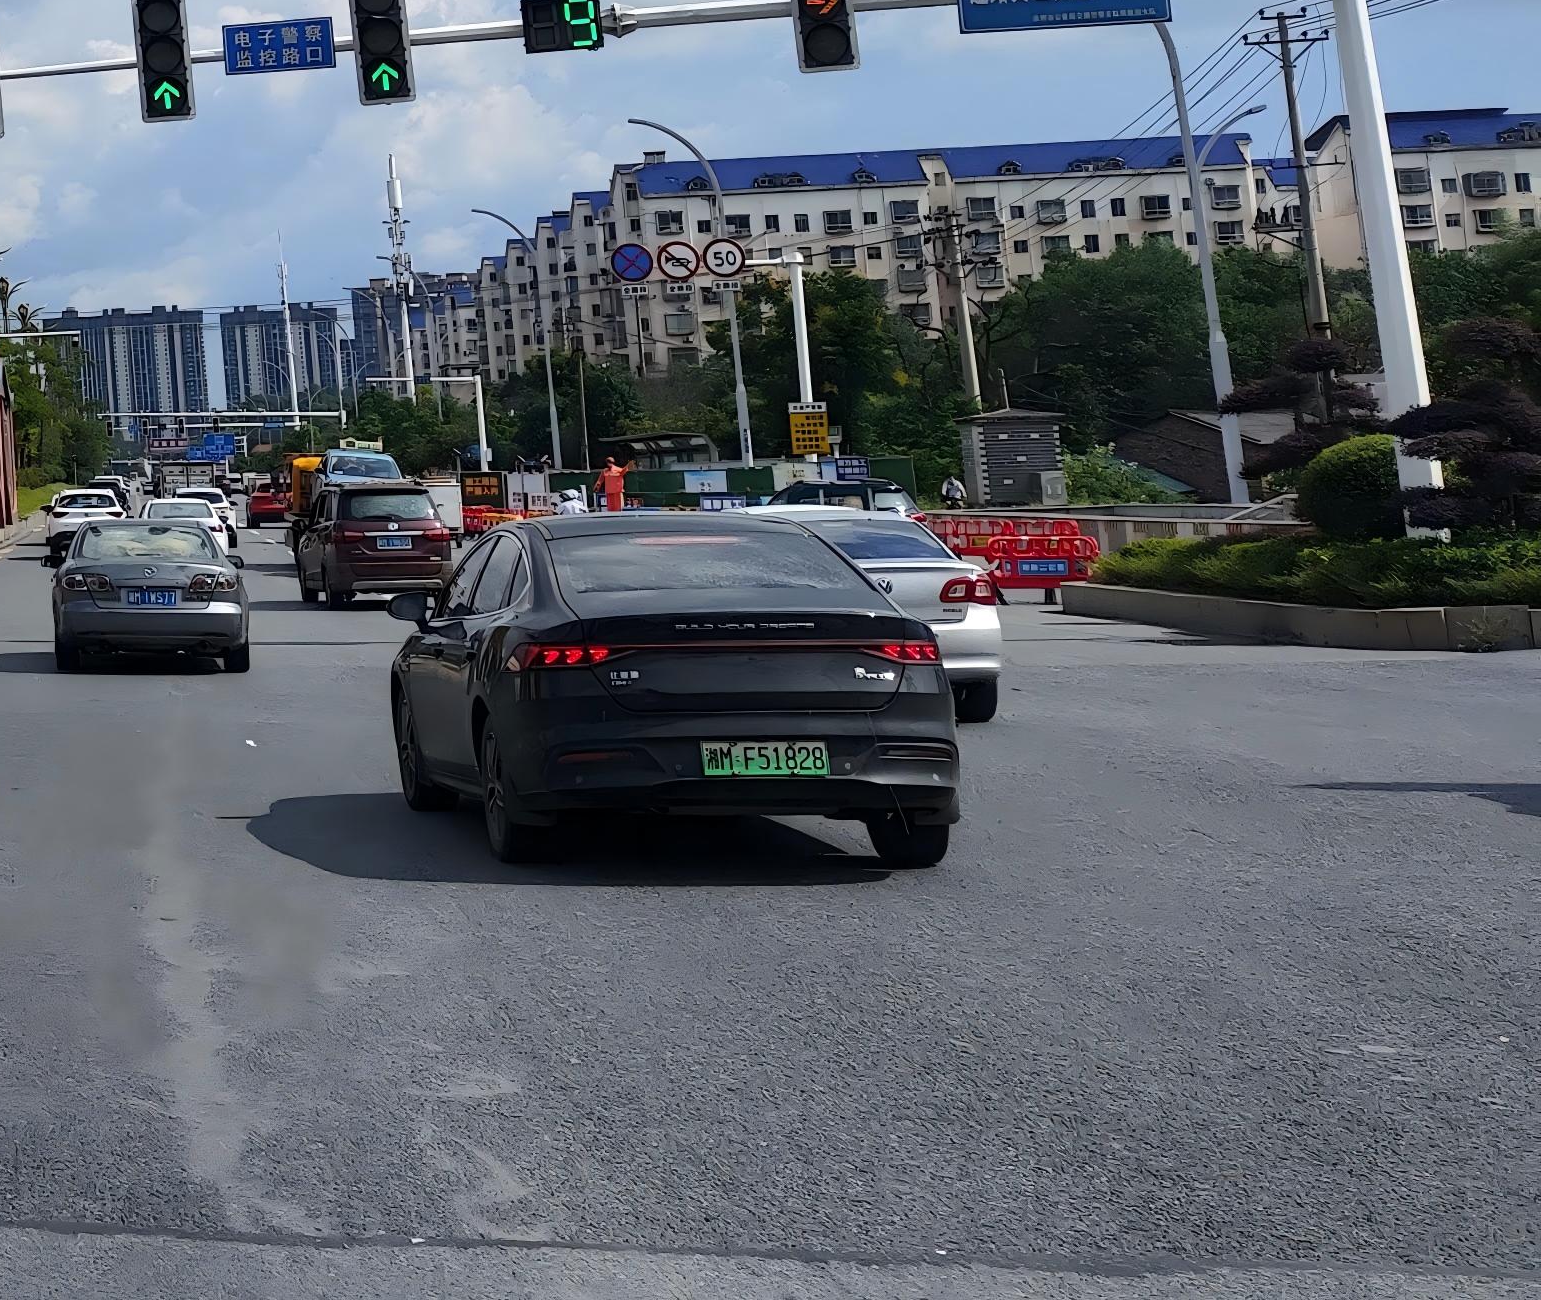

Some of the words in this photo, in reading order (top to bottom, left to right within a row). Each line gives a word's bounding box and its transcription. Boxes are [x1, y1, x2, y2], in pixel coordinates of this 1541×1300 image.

[234, 25, 323, 48] 电子警察
[235, 46, 324, 69] 监控路口
[713, 250, 737, 267] 50
